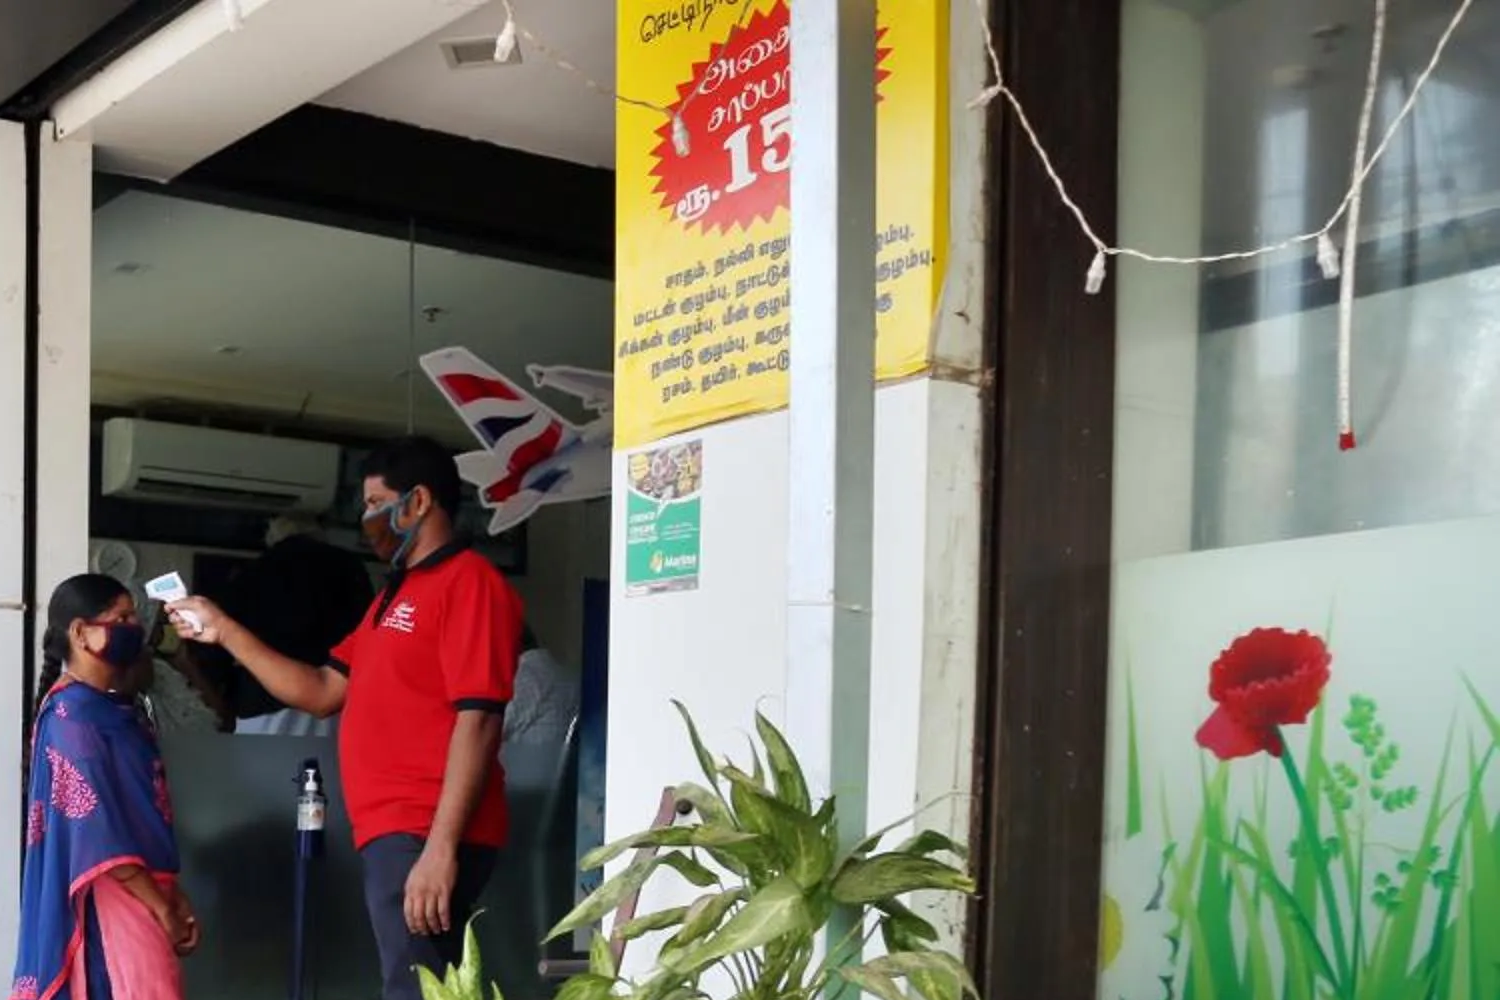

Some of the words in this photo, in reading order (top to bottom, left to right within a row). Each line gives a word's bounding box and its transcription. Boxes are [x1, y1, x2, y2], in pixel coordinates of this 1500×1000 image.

[699, 26, 790, 95] அசை
[708, 65, 792, 131] சாப்பா
[676, 102, 792, 222] ரூ.15
